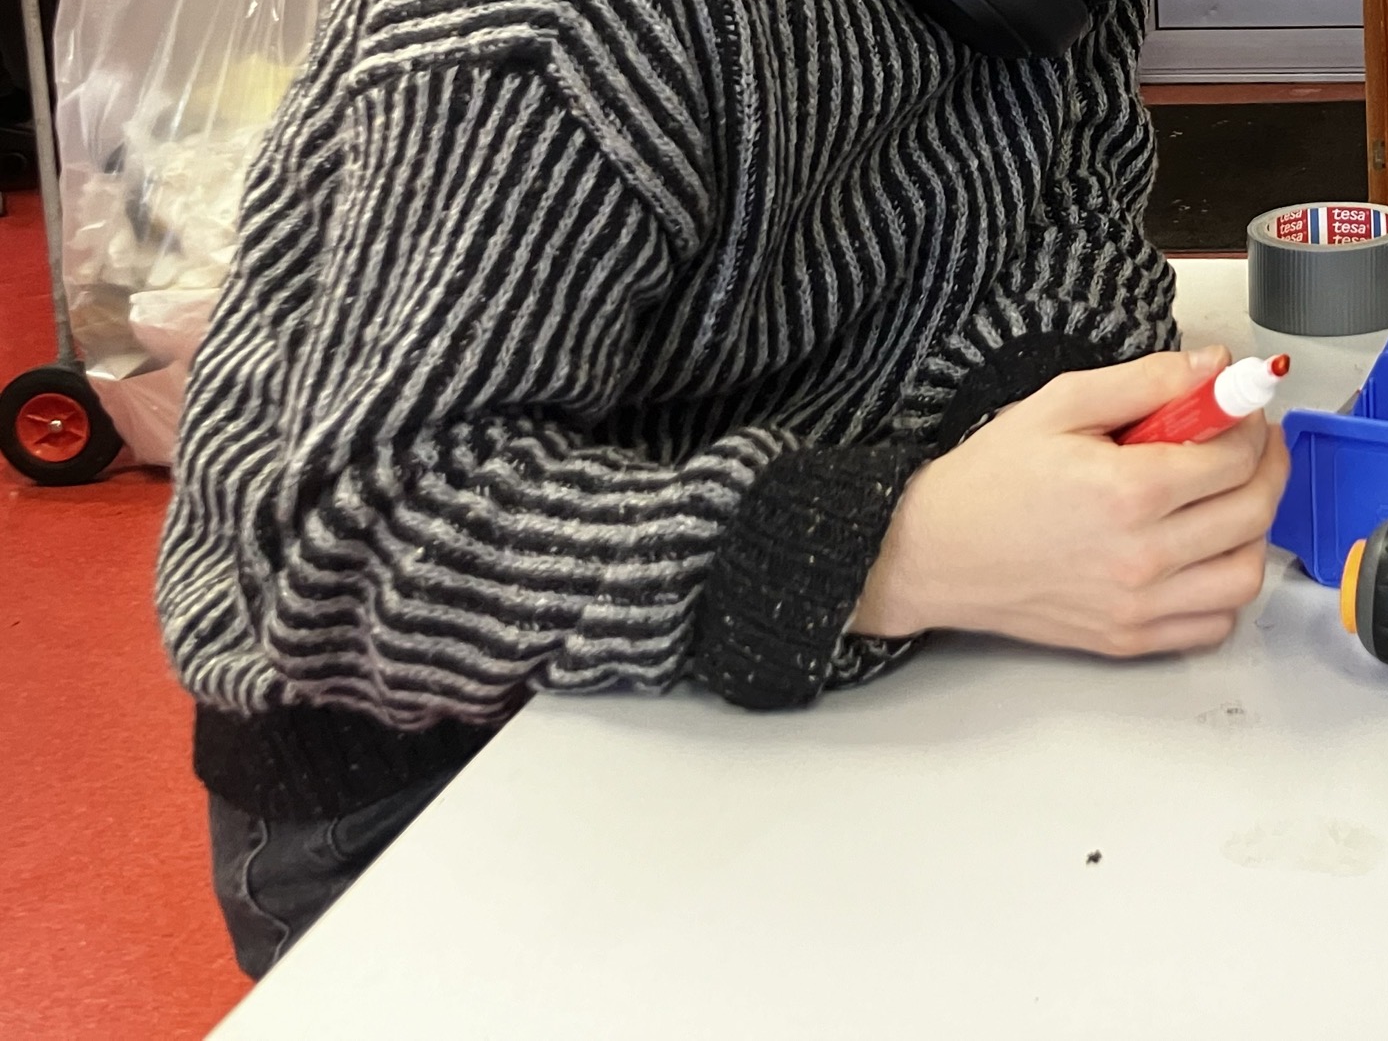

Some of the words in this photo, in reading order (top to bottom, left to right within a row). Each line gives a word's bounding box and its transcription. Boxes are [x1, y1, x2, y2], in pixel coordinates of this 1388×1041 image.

[1332, 208, 1365, 221] tesa
[1280, 220, 1303, 234] tesa
[1332, 221, 1366, 234] tesa
